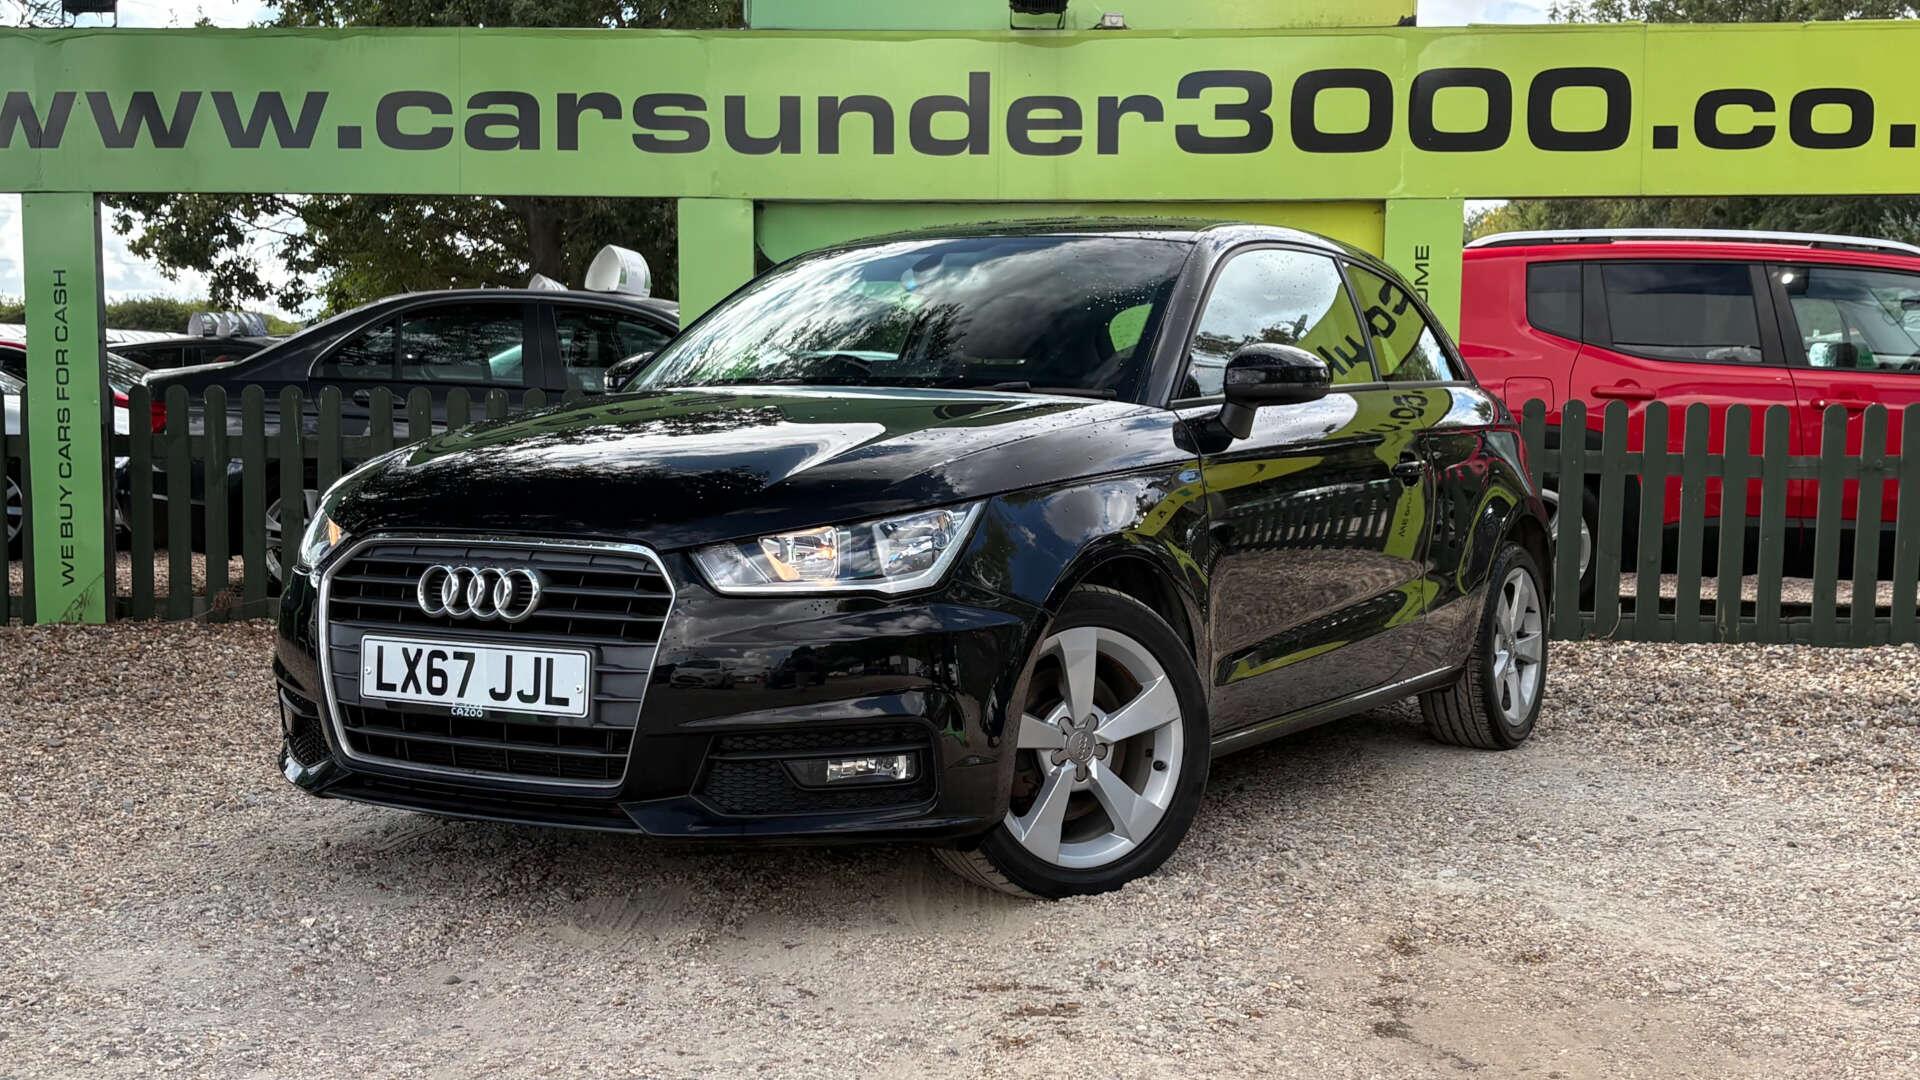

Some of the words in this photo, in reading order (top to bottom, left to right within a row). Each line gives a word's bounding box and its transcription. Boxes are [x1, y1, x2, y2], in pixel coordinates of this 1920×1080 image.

[53, 269, 69, 342] CASH
[55, 348, 70, 401] FOR
[56, 407, 72, 479] CARS
[57, 484, 74, 539] BUY
[60, 544, 75, 588] WE
[376, 645, 476, 698] LX67
[488, 654, 570, 707] JJL
[451, 707, 483, 718] CAZOO
